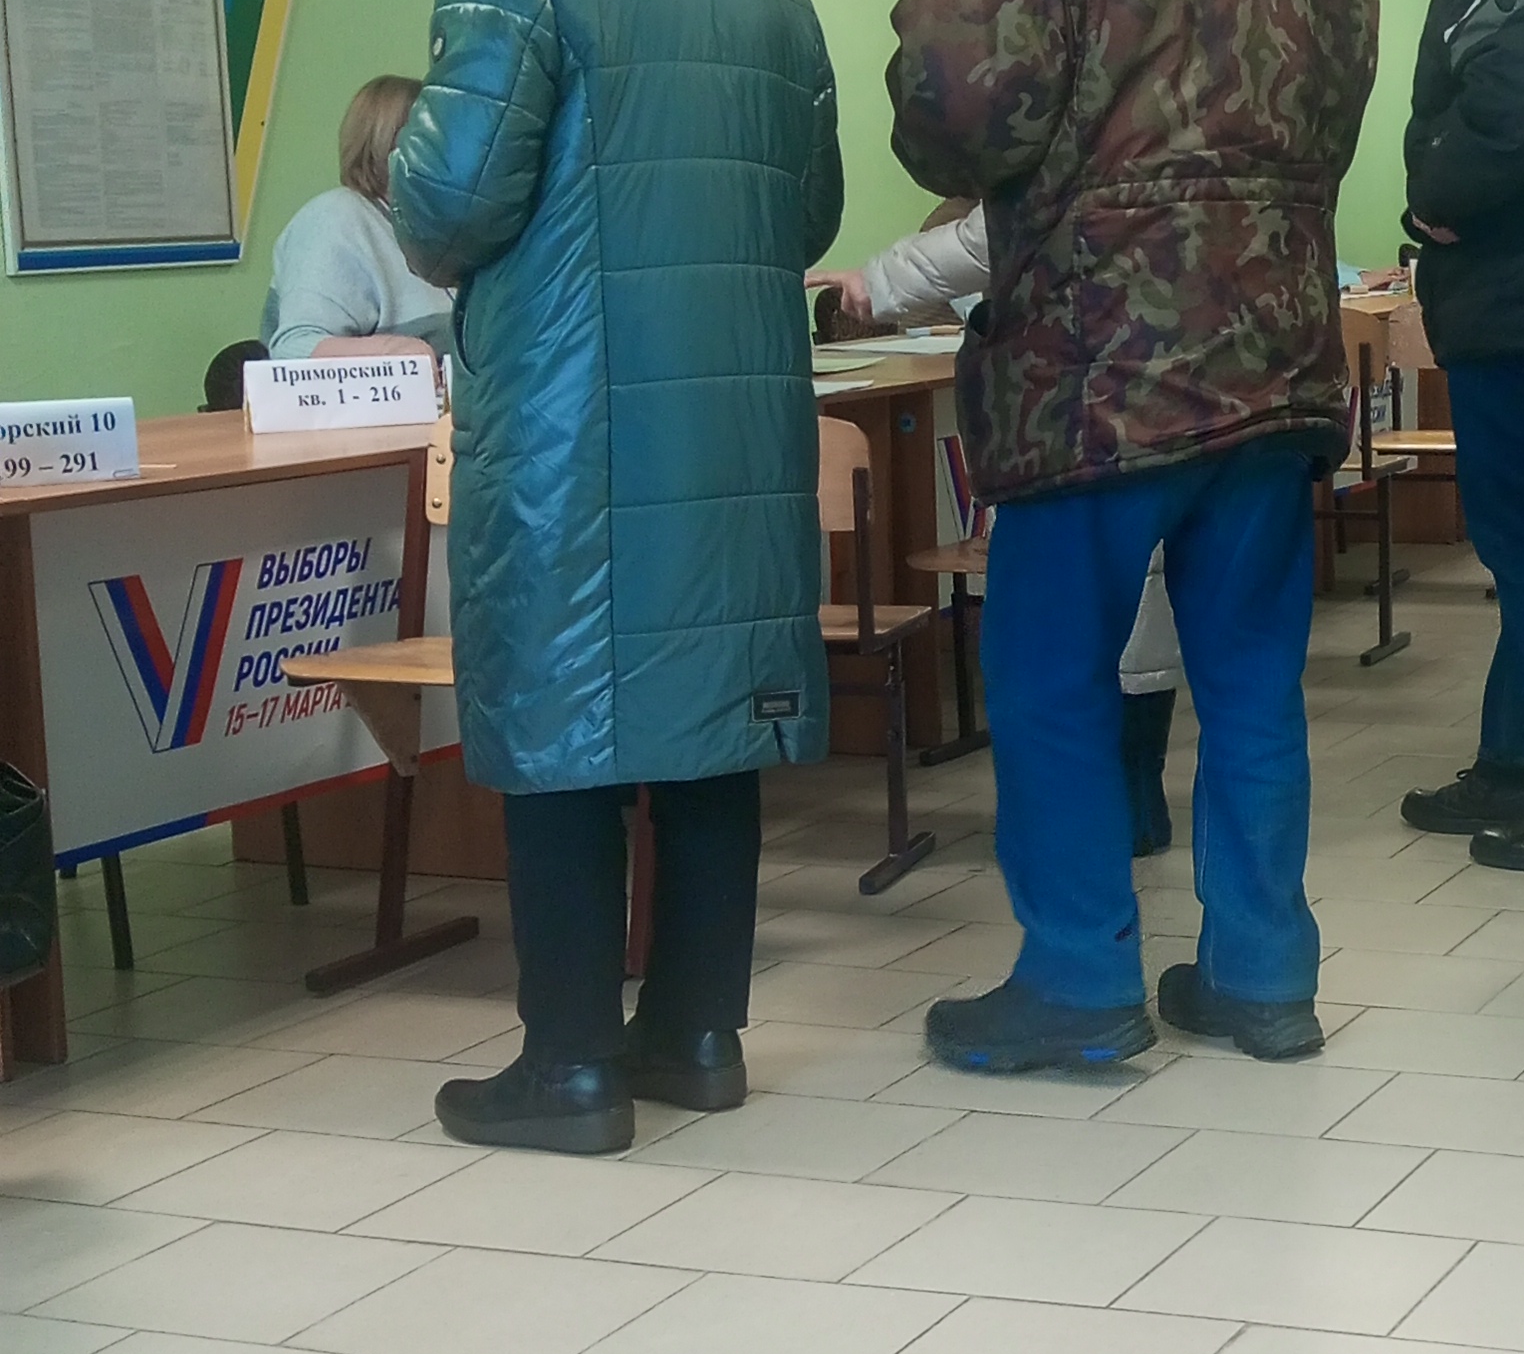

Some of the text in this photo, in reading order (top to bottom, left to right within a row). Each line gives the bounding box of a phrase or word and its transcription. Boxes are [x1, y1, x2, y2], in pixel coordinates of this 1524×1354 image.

[272, 360, 419, 386] Приморский 12
[298, 394, 327, 407] кв.
[338, 388, 346, 405] 1
[370, 385, 402, 403] 216
[92, 411, 116, 433] 10
[0, 456, 32, 481] 99
[60, 451, 99, 475] 291
[257, 537, 373, 590] ВЫБОРЫ
[245, 576, 401, 641] ПРЕЗИДЕНТА
[280, 682, 345, 724] МАРТА
